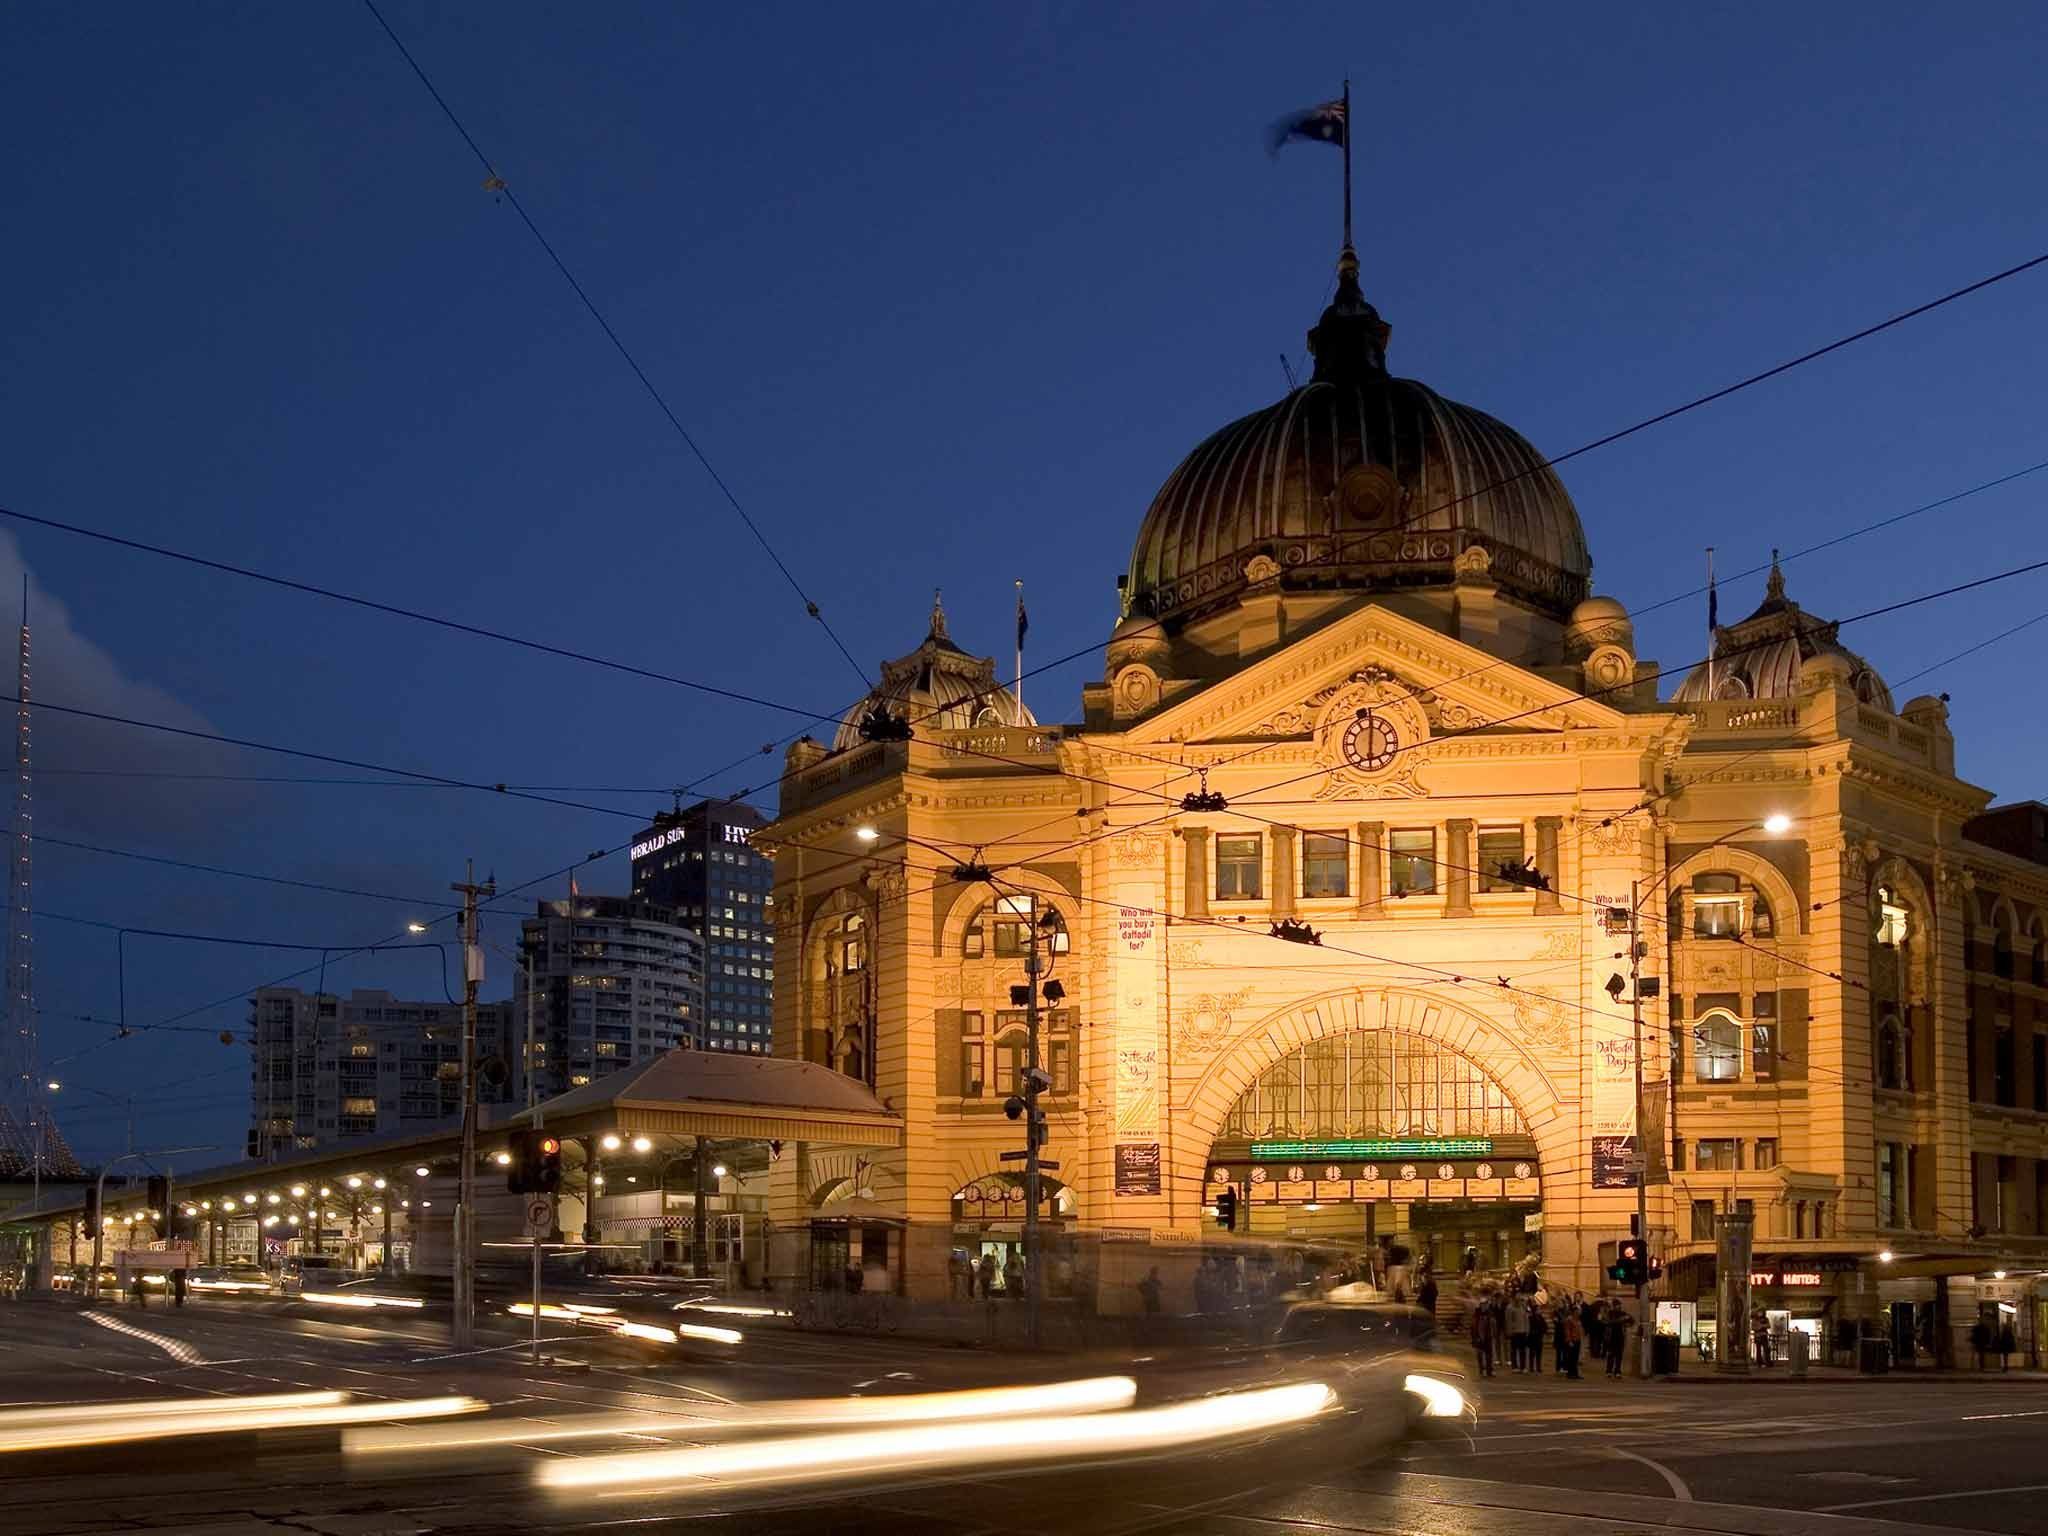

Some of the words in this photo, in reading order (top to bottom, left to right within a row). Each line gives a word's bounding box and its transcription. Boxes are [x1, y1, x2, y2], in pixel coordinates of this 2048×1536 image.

[725, 825, 755, 845] HW
[631, 835, 665, 860] HERALD
[667, 827, 685, 844] SUN
[1595, 895, 1612, 904] Who
[1615, 894, 1629, 903] will
[1120, 908, 1137, 917] Who
[1140, 908, 1153, 917] will
[1119, 921, 1132, 930] you
[1134, 920, 1147, 929] buy
[1122, 930, 1152, 939] daffodil
[1129, 941, 1145, 950] for?
[1606, 1054, 1627, 1074] Day
[1751, 1273, 1774, 1286] ITY
[1783, 1273, 1820, 1286] HATTERS
